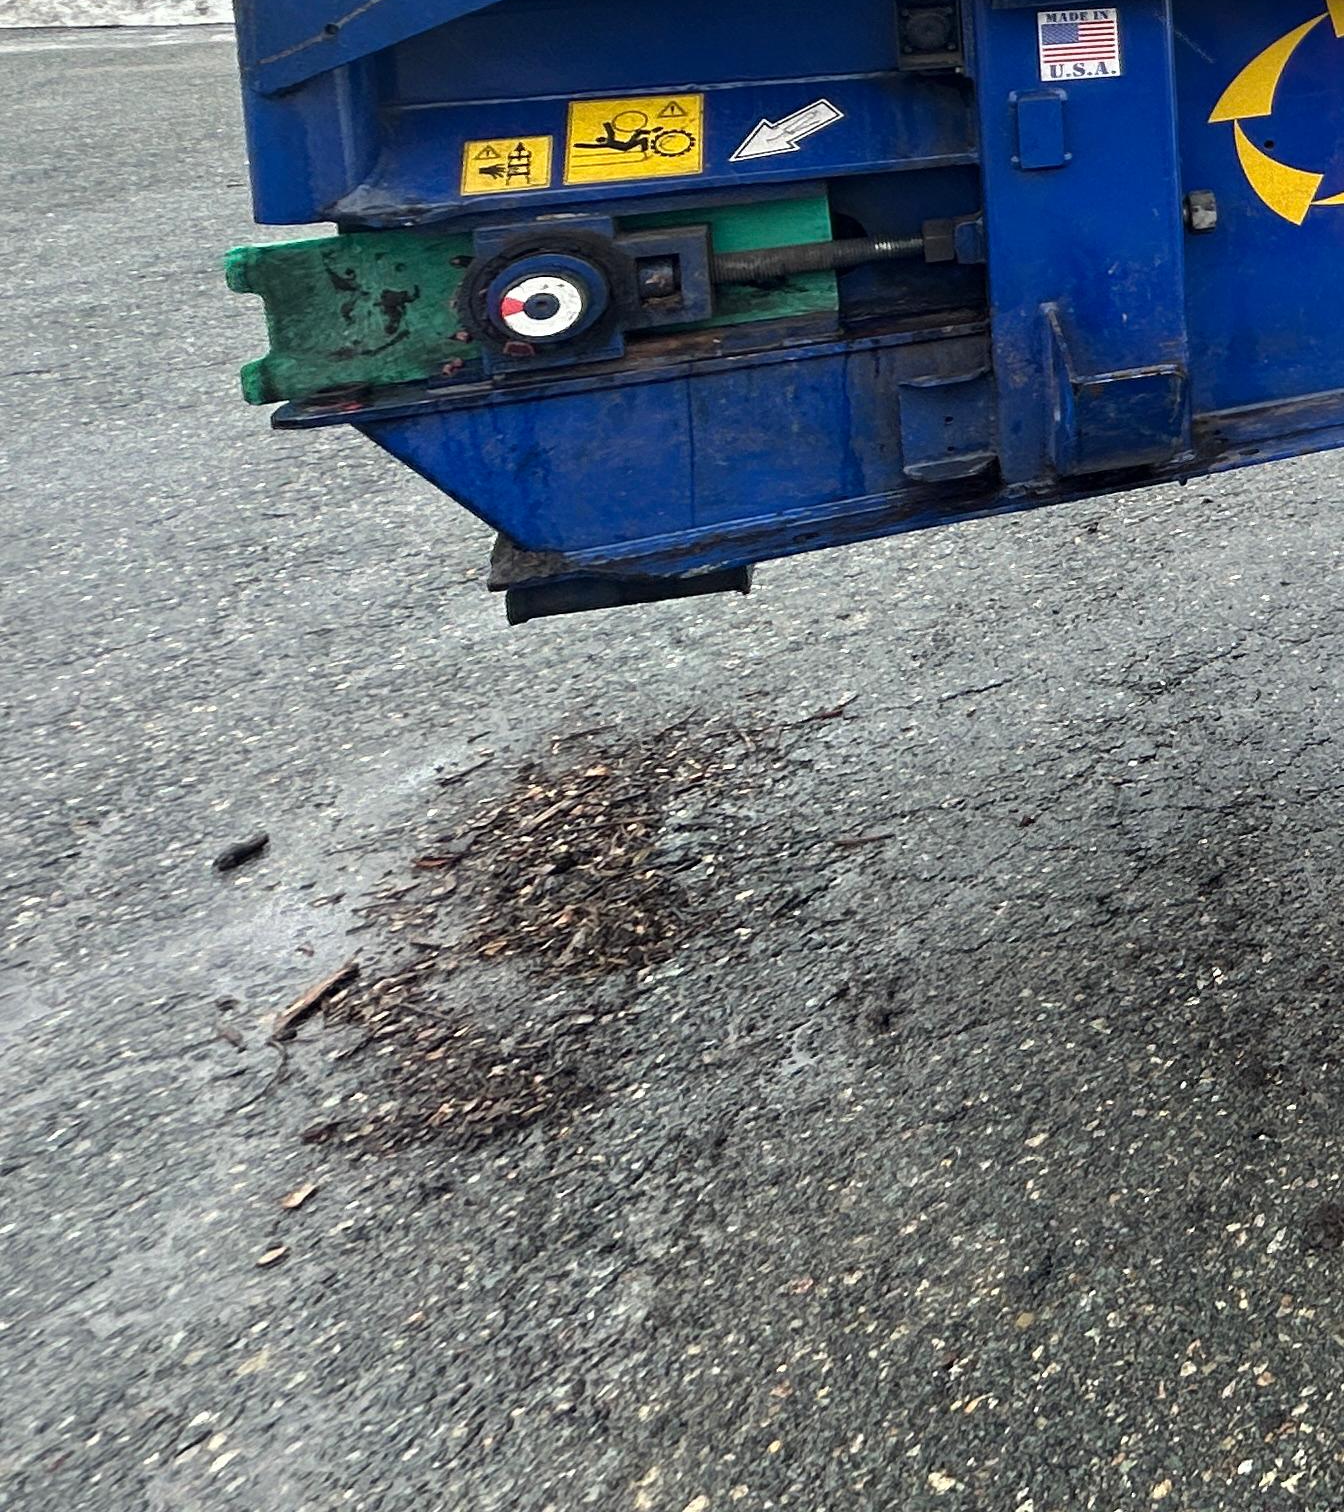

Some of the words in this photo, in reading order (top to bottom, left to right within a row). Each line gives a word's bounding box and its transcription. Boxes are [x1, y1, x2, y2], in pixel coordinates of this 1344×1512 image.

[1045, 11, 1088, 23] MADE
[1093, 9, 1110, 20] IN
[1049, 61, 1117, 79] U.S.A.
